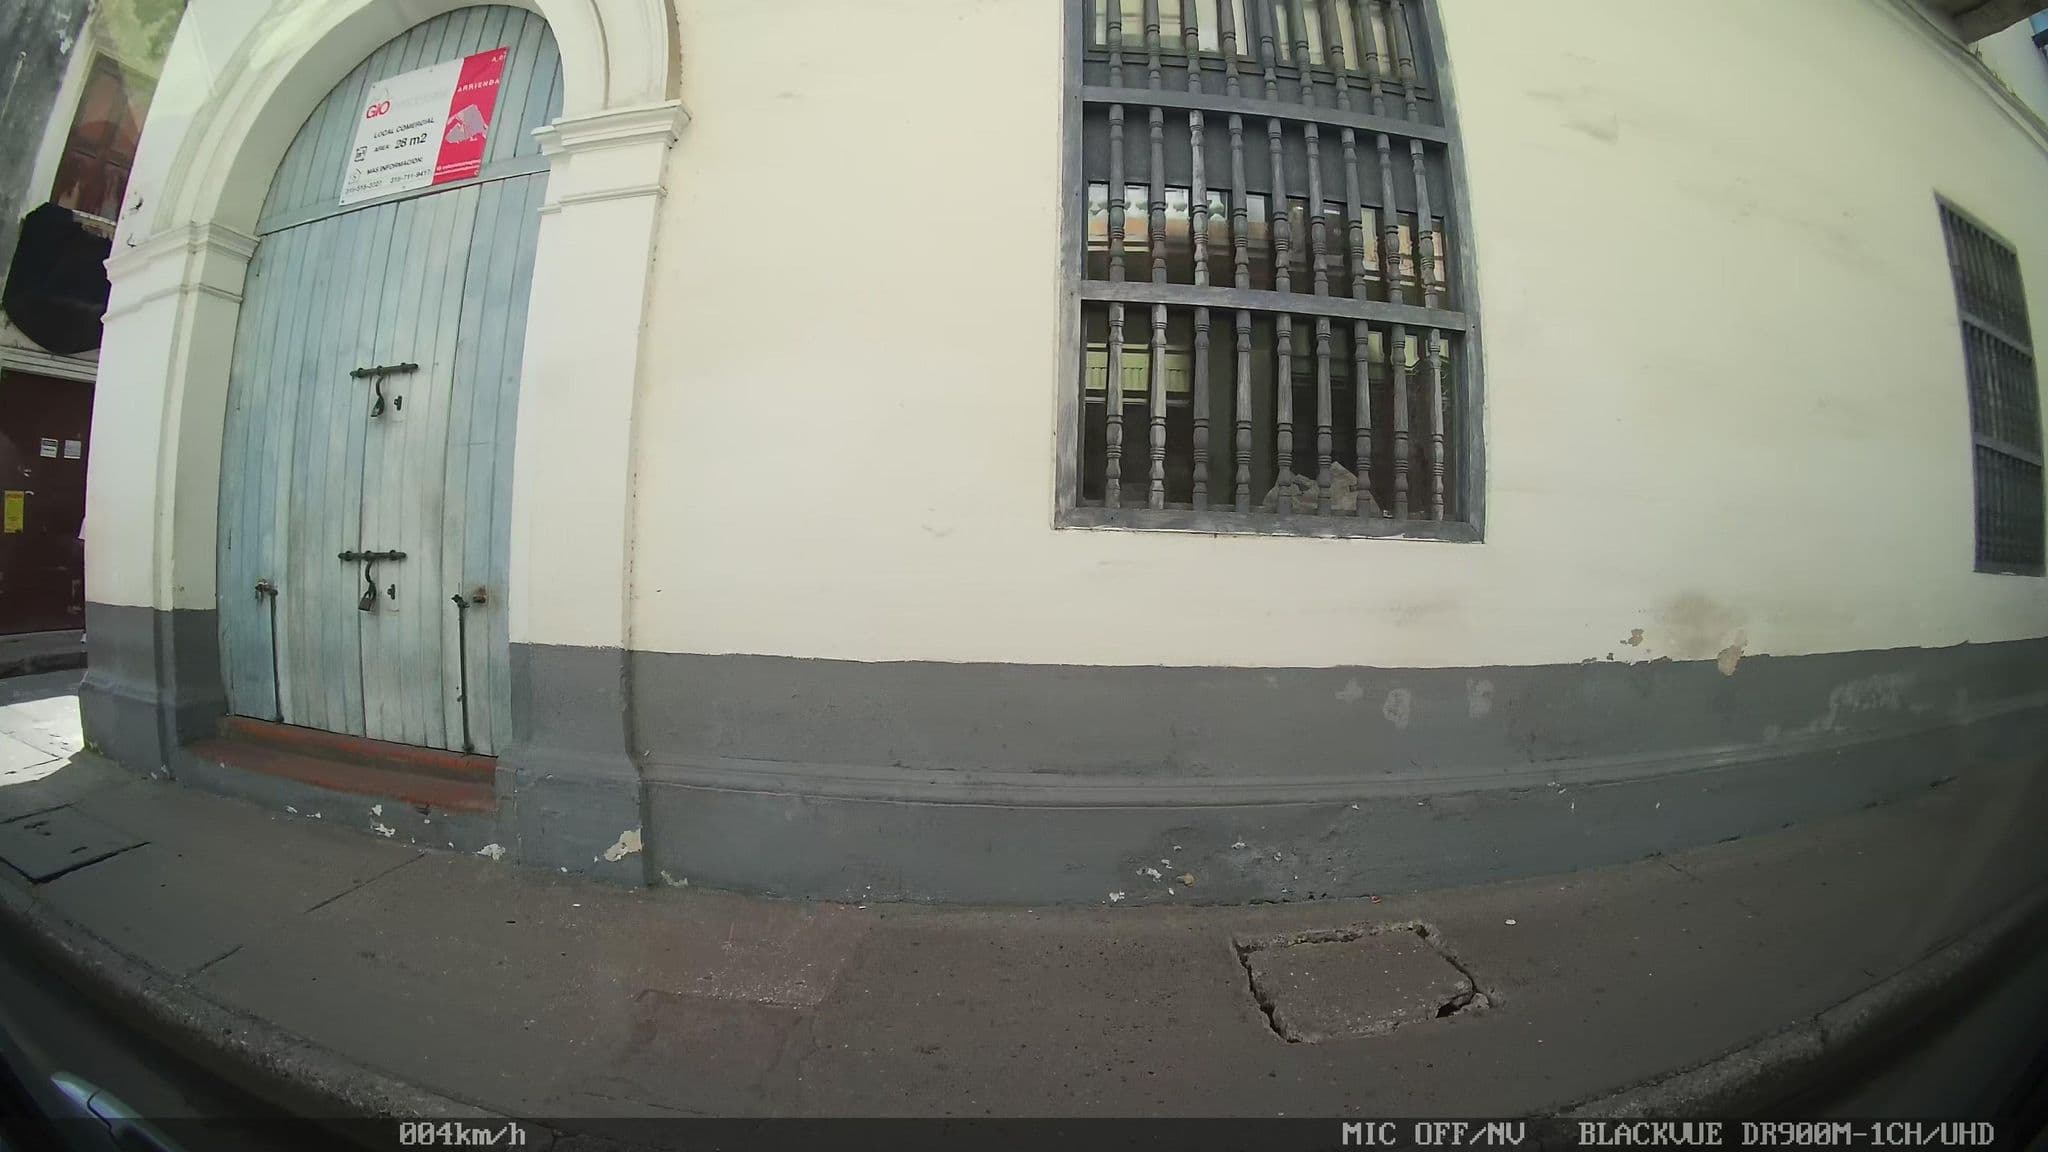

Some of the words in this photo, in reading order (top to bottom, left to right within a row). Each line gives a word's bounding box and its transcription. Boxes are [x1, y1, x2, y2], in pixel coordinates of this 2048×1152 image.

[457, 78, 500, 92] ARRIENDA
[373, 128, 394, 139] LOCAL
[396, 117, 435, 132] COMERCIAL
[394, 137, 408, 149] 28
[409, 132, 428, 145] m2
